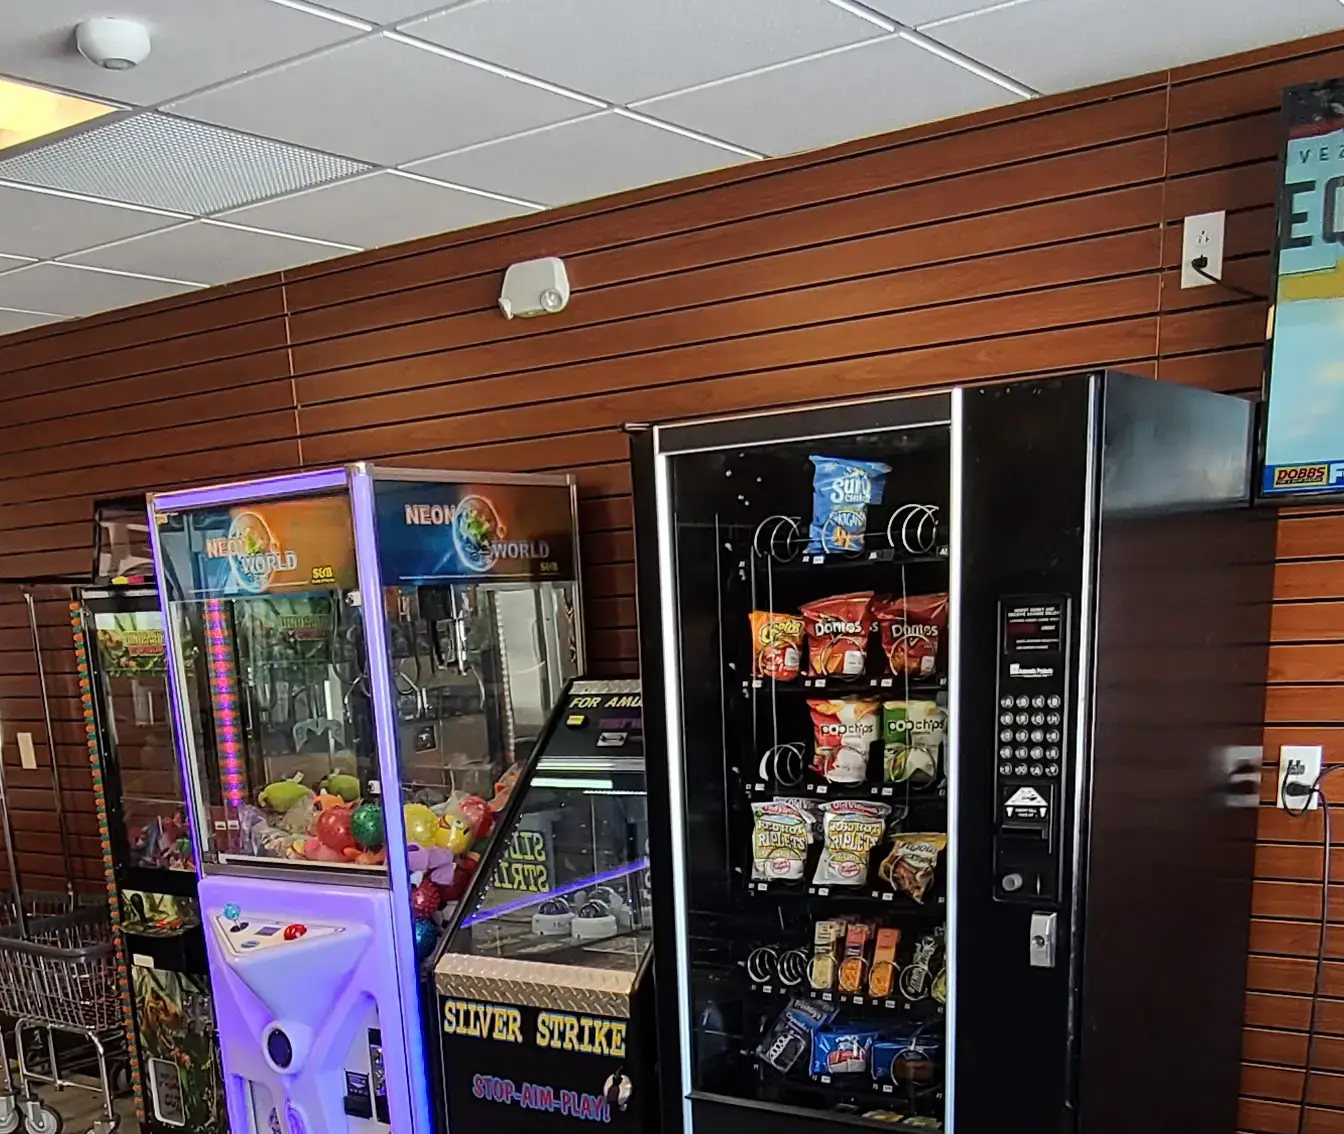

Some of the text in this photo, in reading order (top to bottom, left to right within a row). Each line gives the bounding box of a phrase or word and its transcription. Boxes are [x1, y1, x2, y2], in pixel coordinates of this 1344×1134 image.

[1277, 466, 1326, 480] DOBBS
[404, 503, 457, 526] NEON
[489, 539, 550, 560] WORLD
[240, 550, 298, 574] WORLD
[568, 695, 643, 708] FOR AMU
[758, 832, 806, 850] RIPLETS
[442, 998, 628, 1059] SILVER STRIKE
